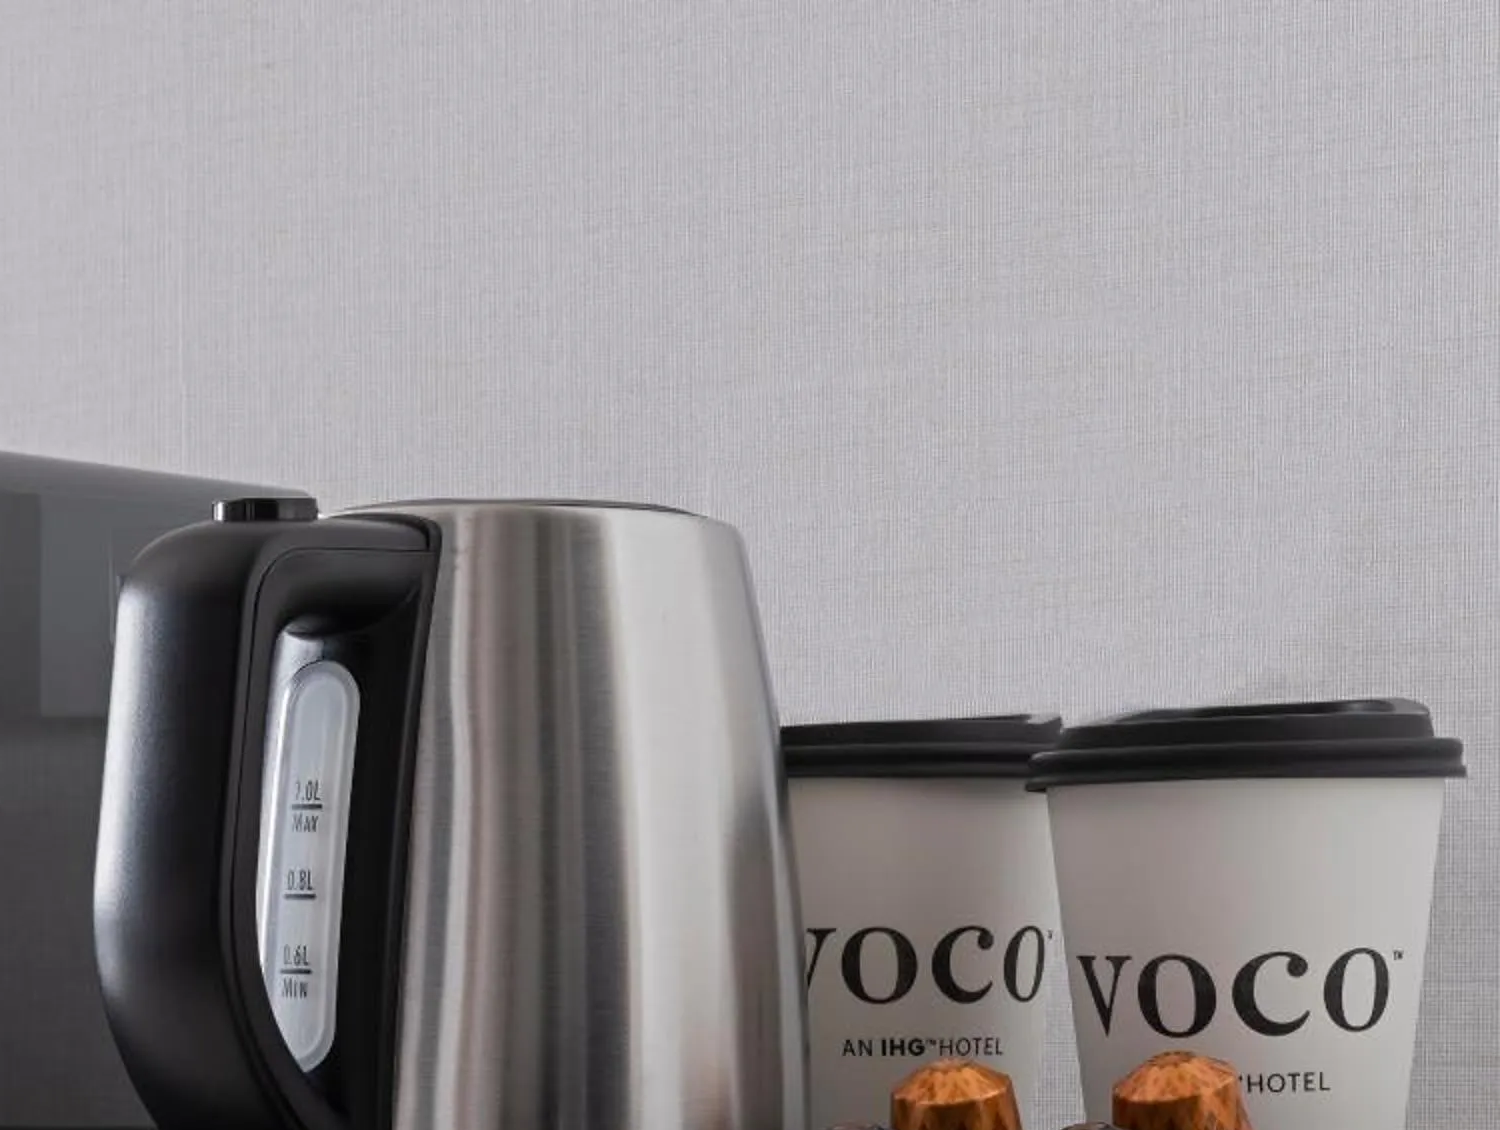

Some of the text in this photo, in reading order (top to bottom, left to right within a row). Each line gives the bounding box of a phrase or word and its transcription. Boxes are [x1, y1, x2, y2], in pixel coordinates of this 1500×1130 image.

[841, 1038, 873, 1057] AN
[939, 1037, 1004, 1056] HOTEL
[1246, 1072, 1331, 1094] HOTEL
